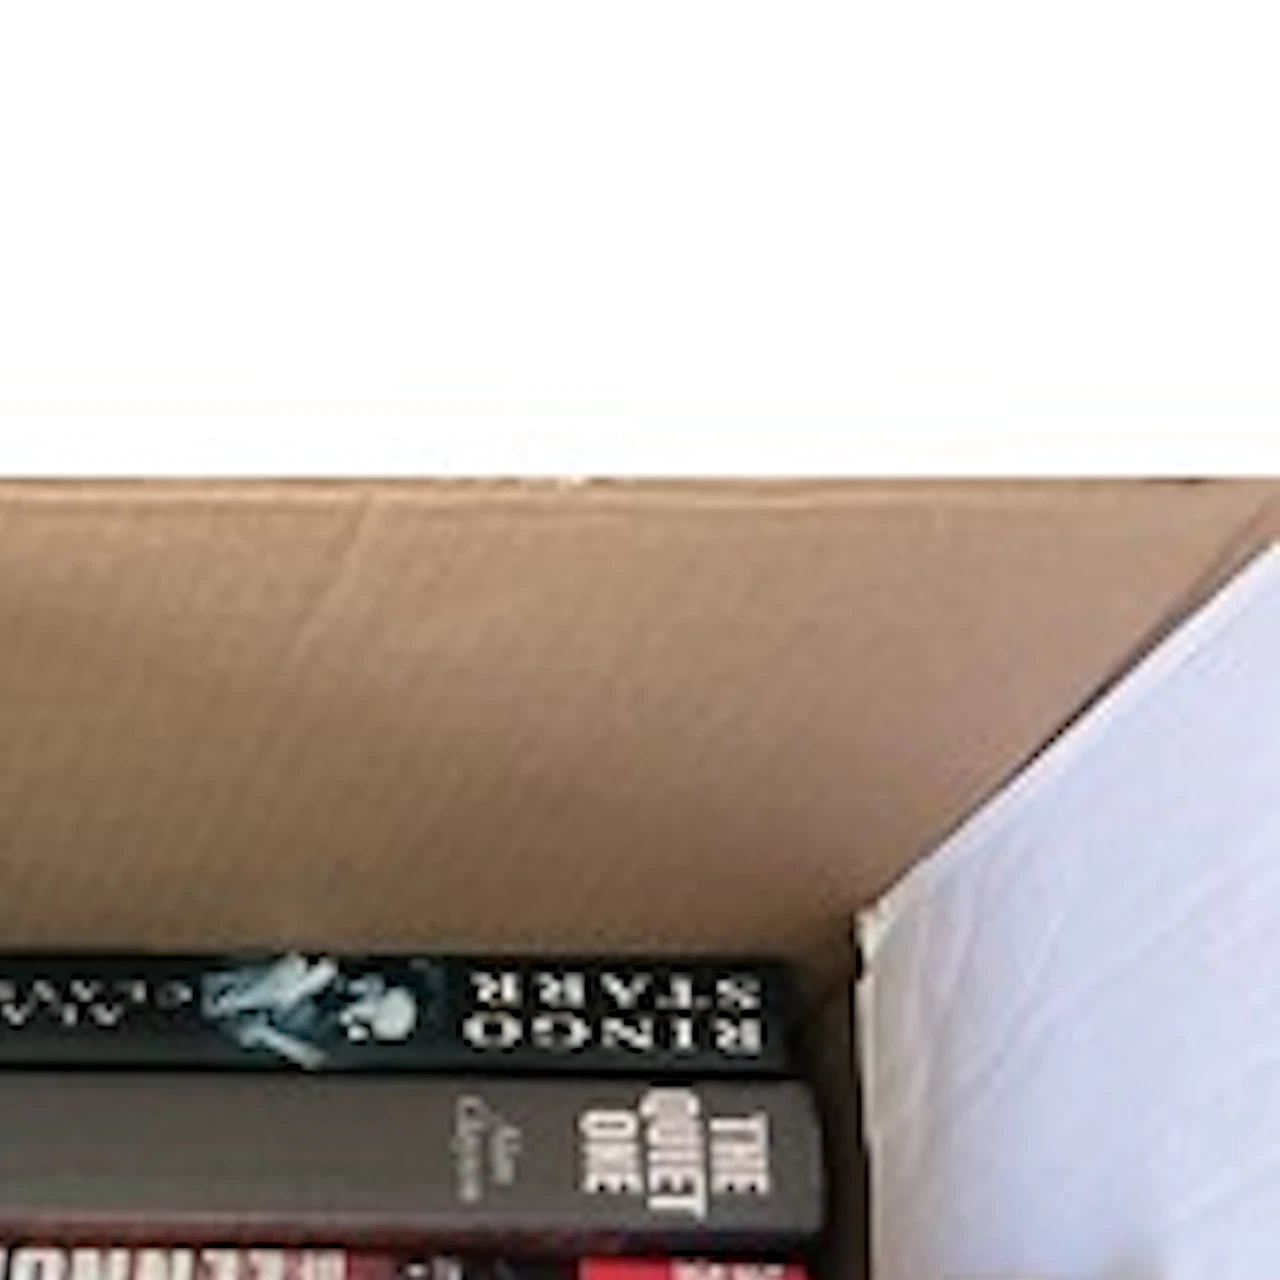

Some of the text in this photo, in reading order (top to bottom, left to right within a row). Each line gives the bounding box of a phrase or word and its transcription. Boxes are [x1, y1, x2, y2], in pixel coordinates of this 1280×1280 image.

[459, 1009, 761, 1053] RINGO
[467, 971, 761, 1012] STARR
[579, 1109, 643, 1195] ONE
[638, 1087, 708, 1219] QUIET
[709, 1113, 772, 1195] THE
